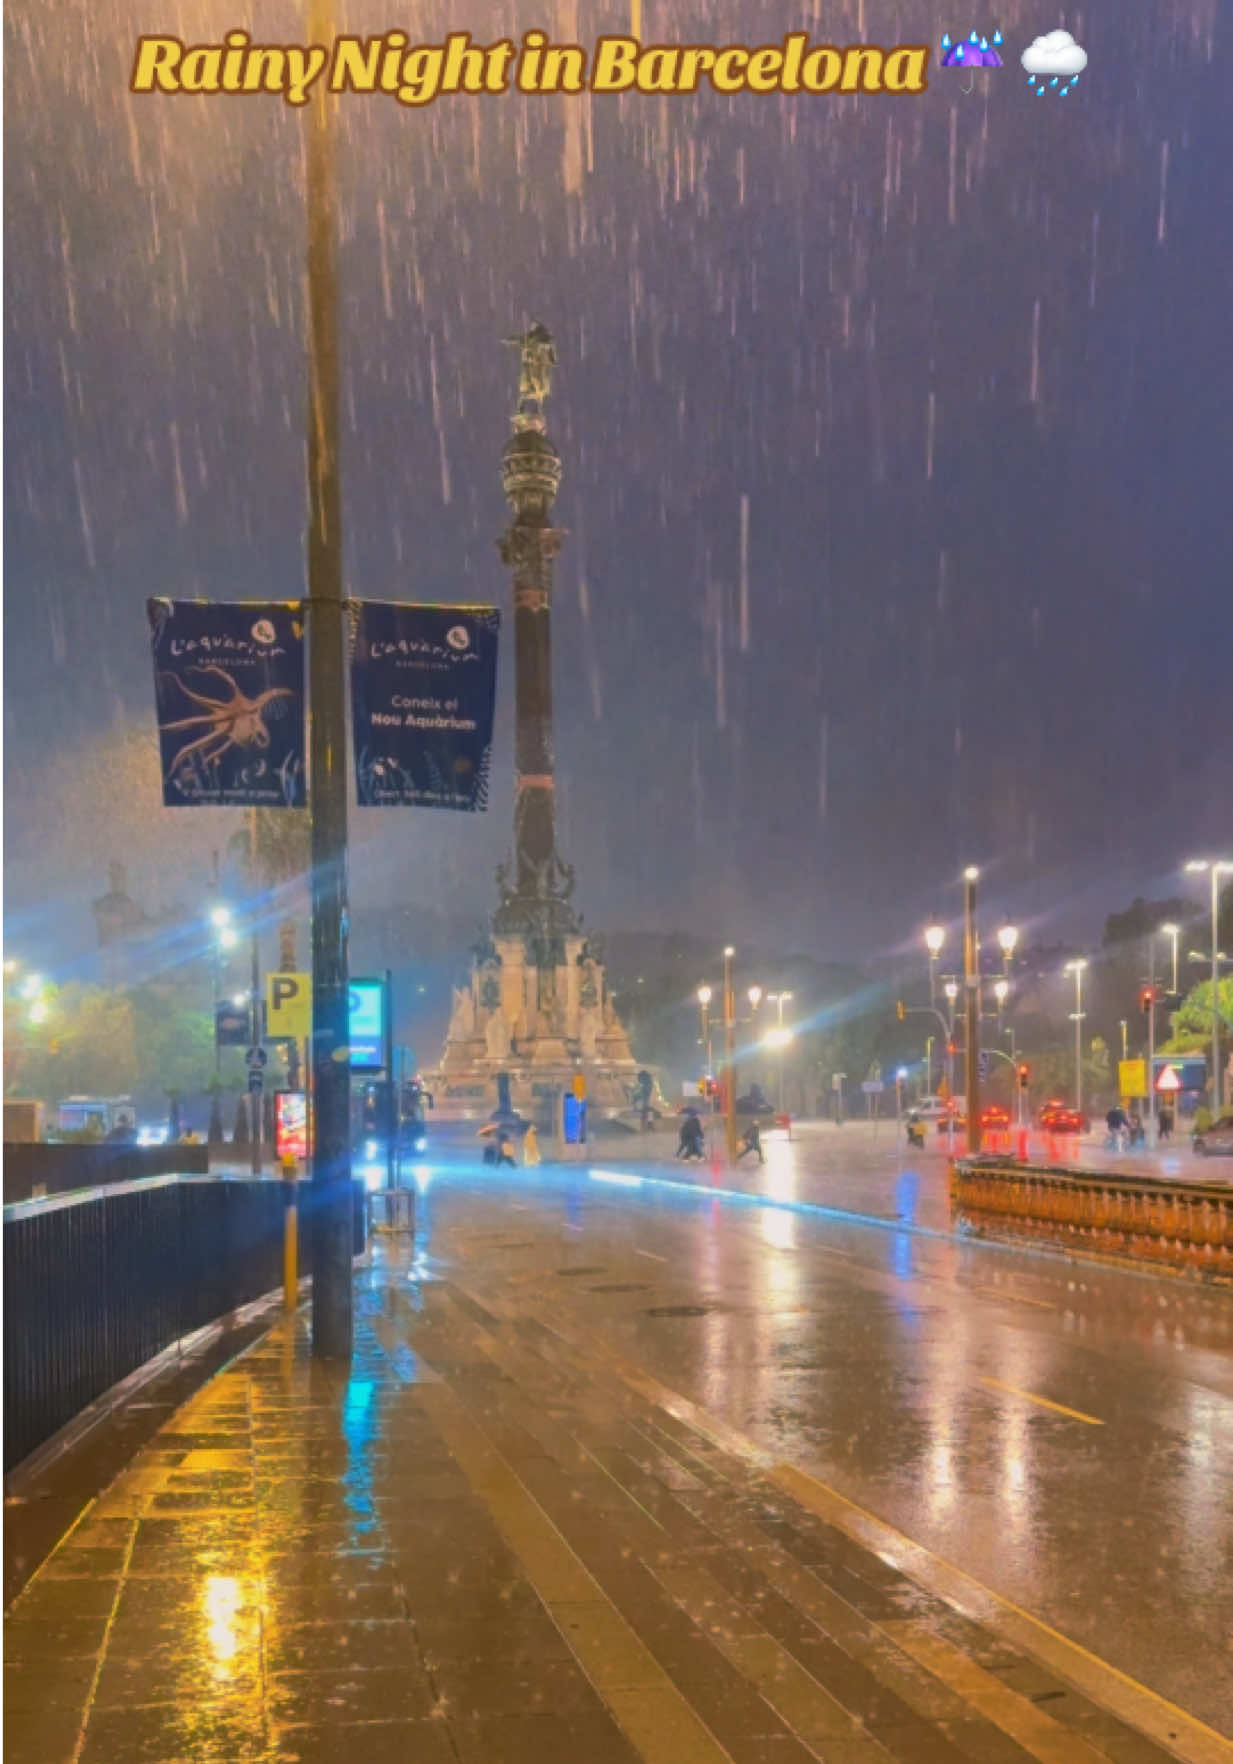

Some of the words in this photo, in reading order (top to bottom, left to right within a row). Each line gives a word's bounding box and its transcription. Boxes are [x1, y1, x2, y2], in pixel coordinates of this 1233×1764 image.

[391, 694, 441, 710] Coneix
[444, 696, 459, 711] el
[371, 711, 402, 727] Nou
[272, 977, 299, 1010] P
